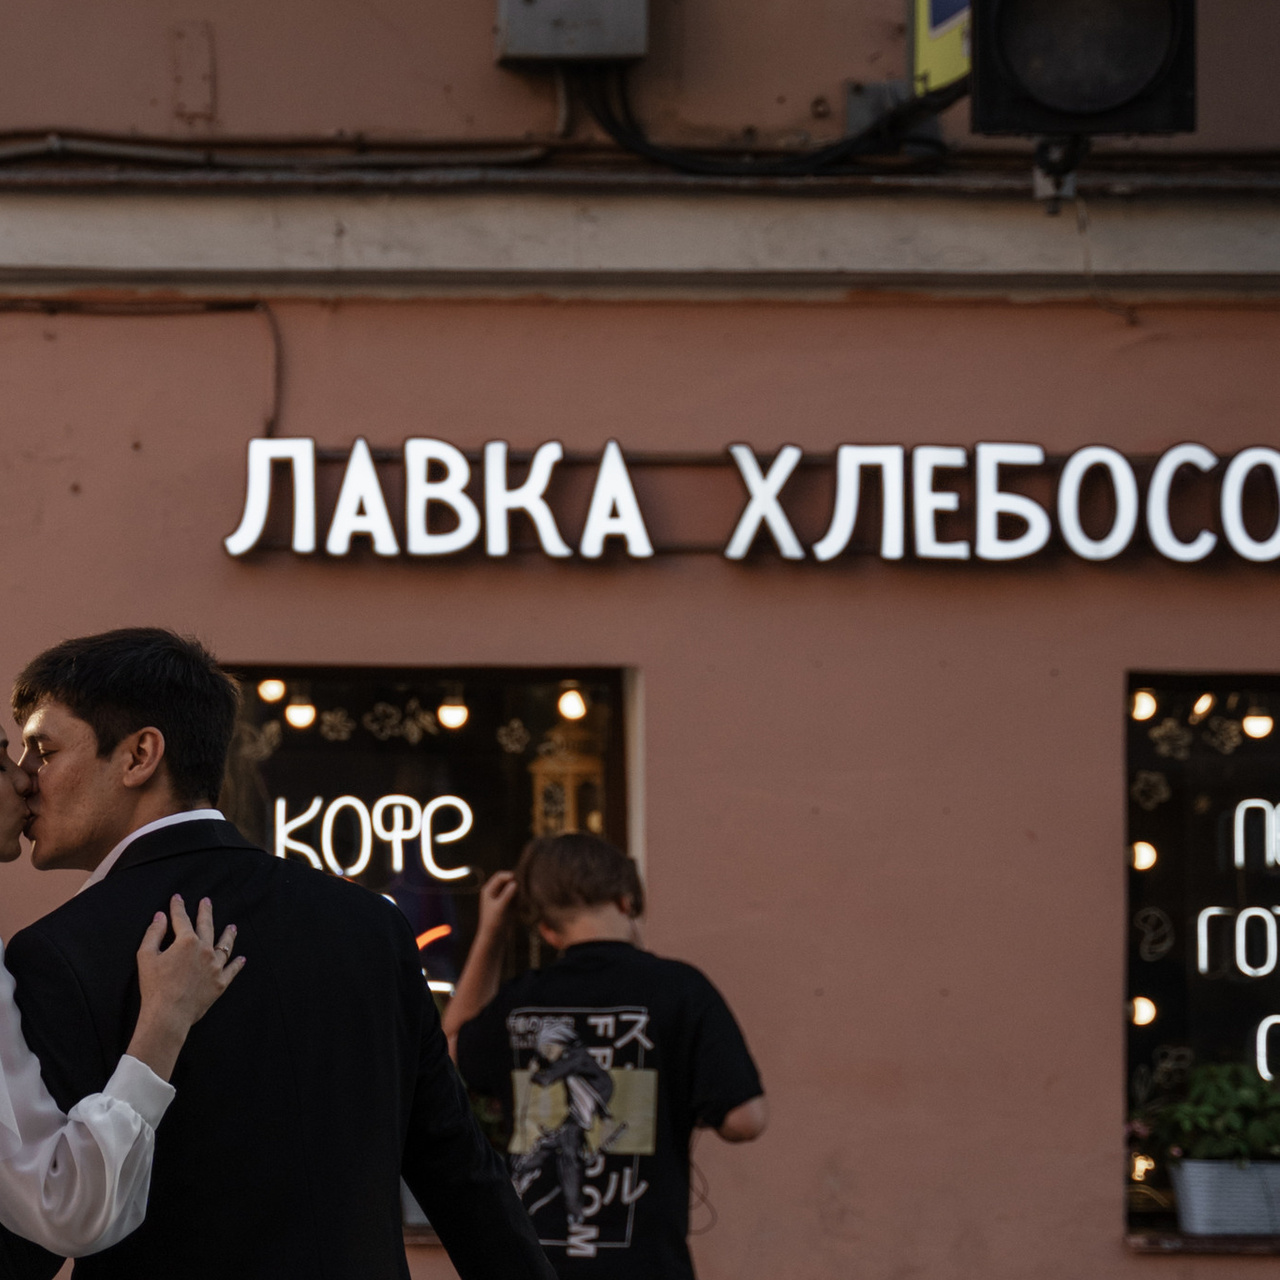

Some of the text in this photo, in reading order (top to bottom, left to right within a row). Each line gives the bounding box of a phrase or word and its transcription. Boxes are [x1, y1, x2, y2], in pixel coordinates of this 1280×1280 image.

[224, 437, 1280, 562] ЛАВКА ХЛЕБОСО
[1233, 797, 1280, 869] П
